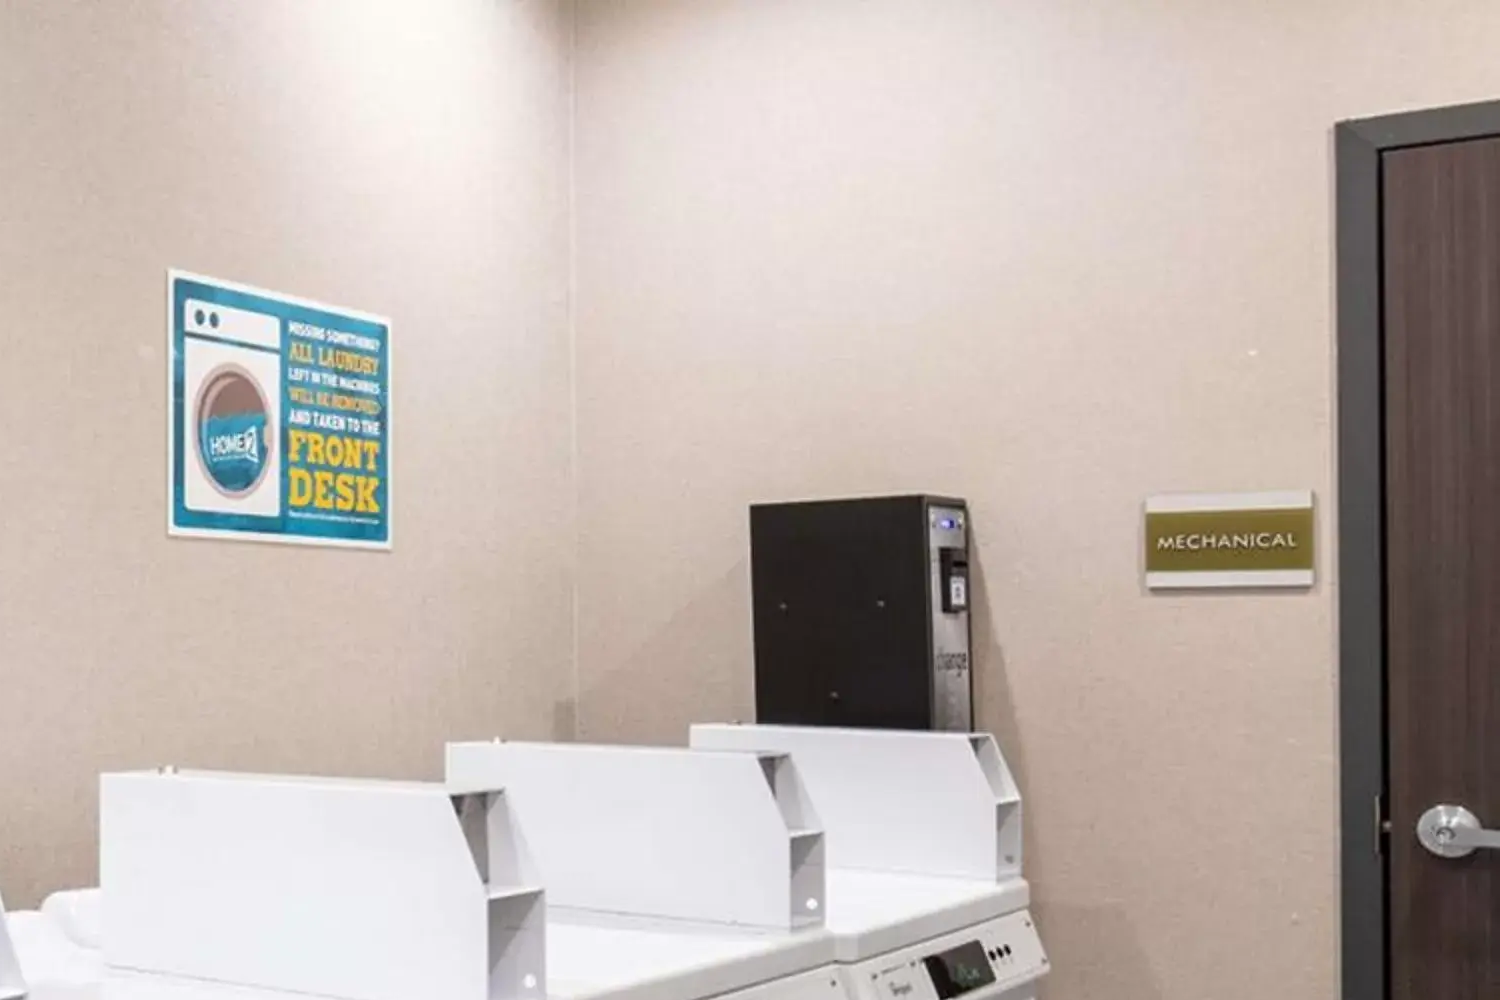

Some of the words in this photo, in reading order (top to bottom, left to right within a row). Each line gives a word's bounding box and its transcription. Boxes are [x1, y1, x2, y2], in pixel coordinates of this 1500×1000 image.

[289, 408, 311, 427] AND
[313, 411, 345, 431] TAKEN
[347, 417, 360, 433] TO
[361, 420, 380, 436] THE
[288, 429, 379, 472] FRONT
[288, 467, 380, 512] DESK
[1157, 532, 1298, 551] MECHANICAL
